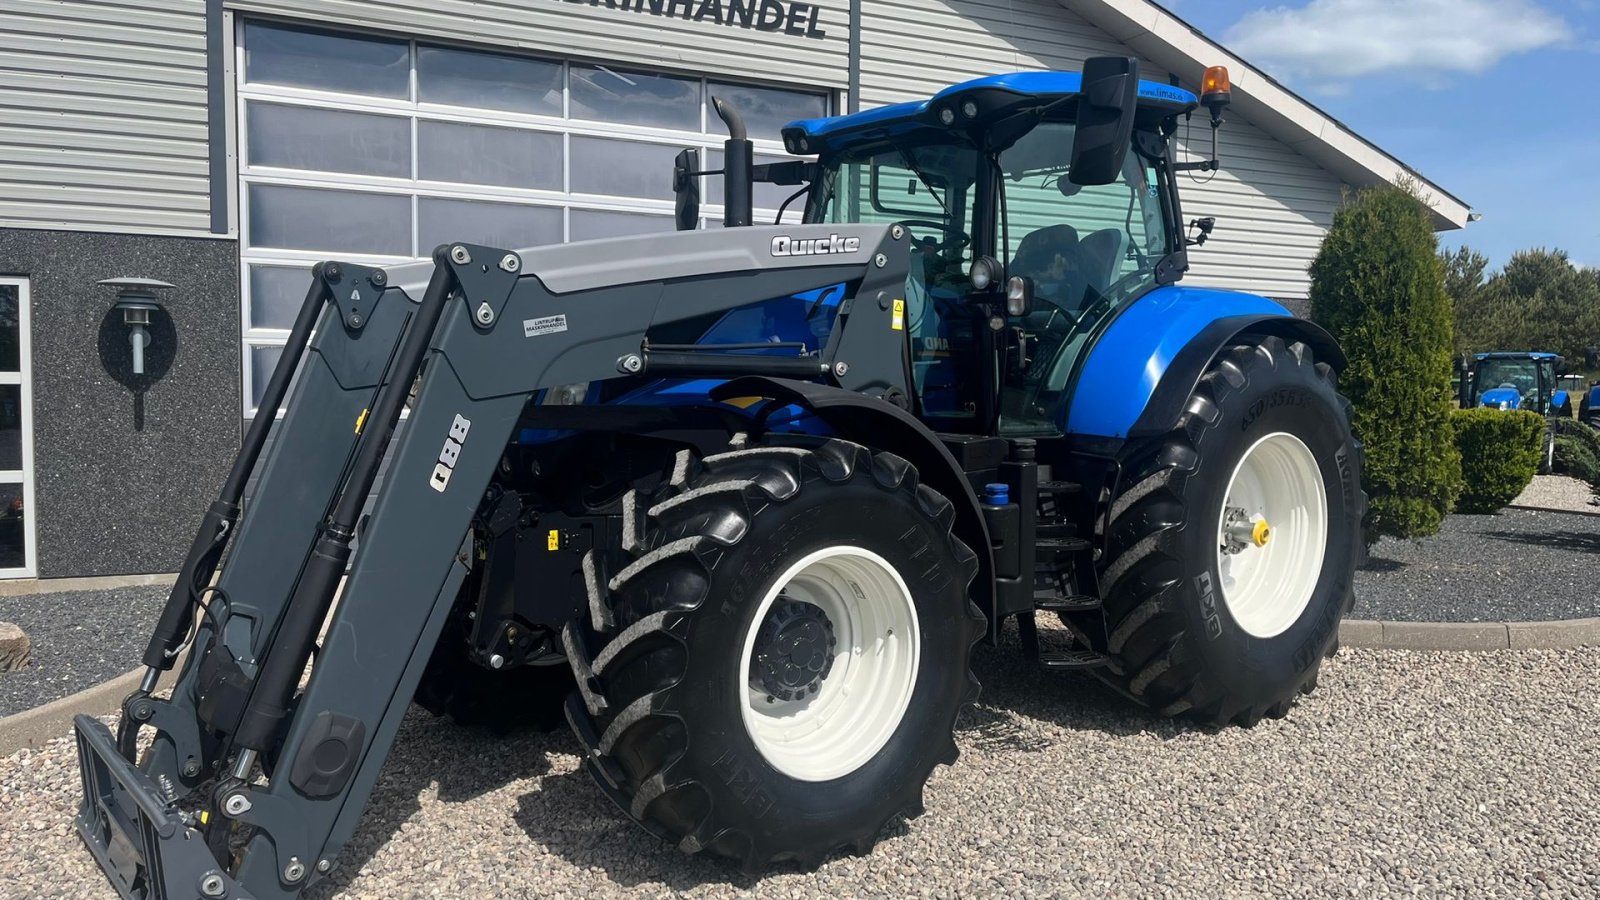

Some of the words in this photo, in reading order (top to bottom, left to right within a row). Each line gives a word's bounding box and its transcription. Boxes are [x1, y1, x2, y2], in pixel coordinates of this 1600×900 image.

[771, 233, 860, 257] Quicke
[526, 321, 566, 331] MASKINHANDEL
[1194, 571, 1222, 640] BKT
